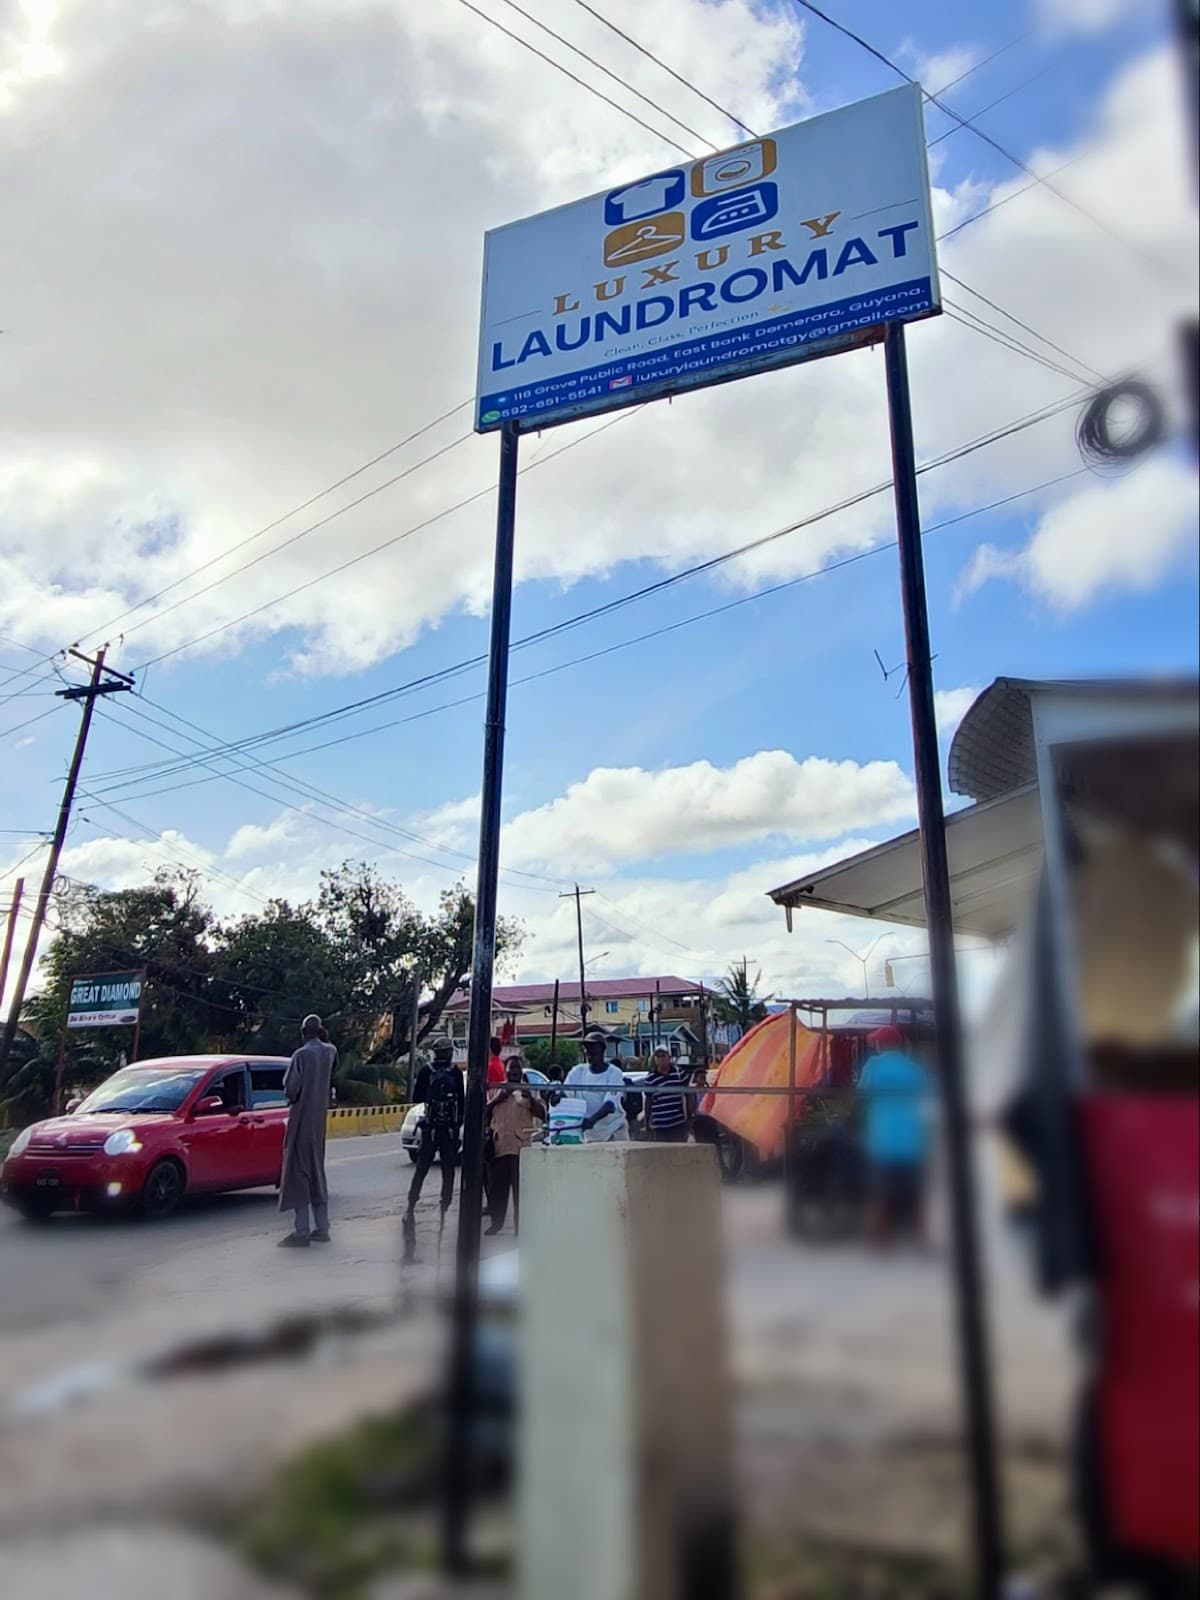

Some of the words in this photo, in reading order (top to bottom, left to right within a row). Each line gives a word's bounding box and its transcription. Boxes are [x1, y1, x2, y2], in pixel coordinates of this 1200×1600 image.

[492, 220, 918, 372] LAUNDROMAT
[552, 211, 841, 316] LUXURY
[534, 380, 577, 394] Grove
[580, 367, 623, 384] Public
[674, 343, 707, 358] East
[711, 333, 751, 349] Bank
[755, 309, 845, 337] Demerara,
[849, 287, 926, 312] Guyana.
[636, 300, 929, 382] luxurylaundromatgy@gmail.com
[689, 311, 759, 334] Perfection
[71, 985, 100, 1005] GREAT
[101, 982, 141, 1002] DIAMOND
